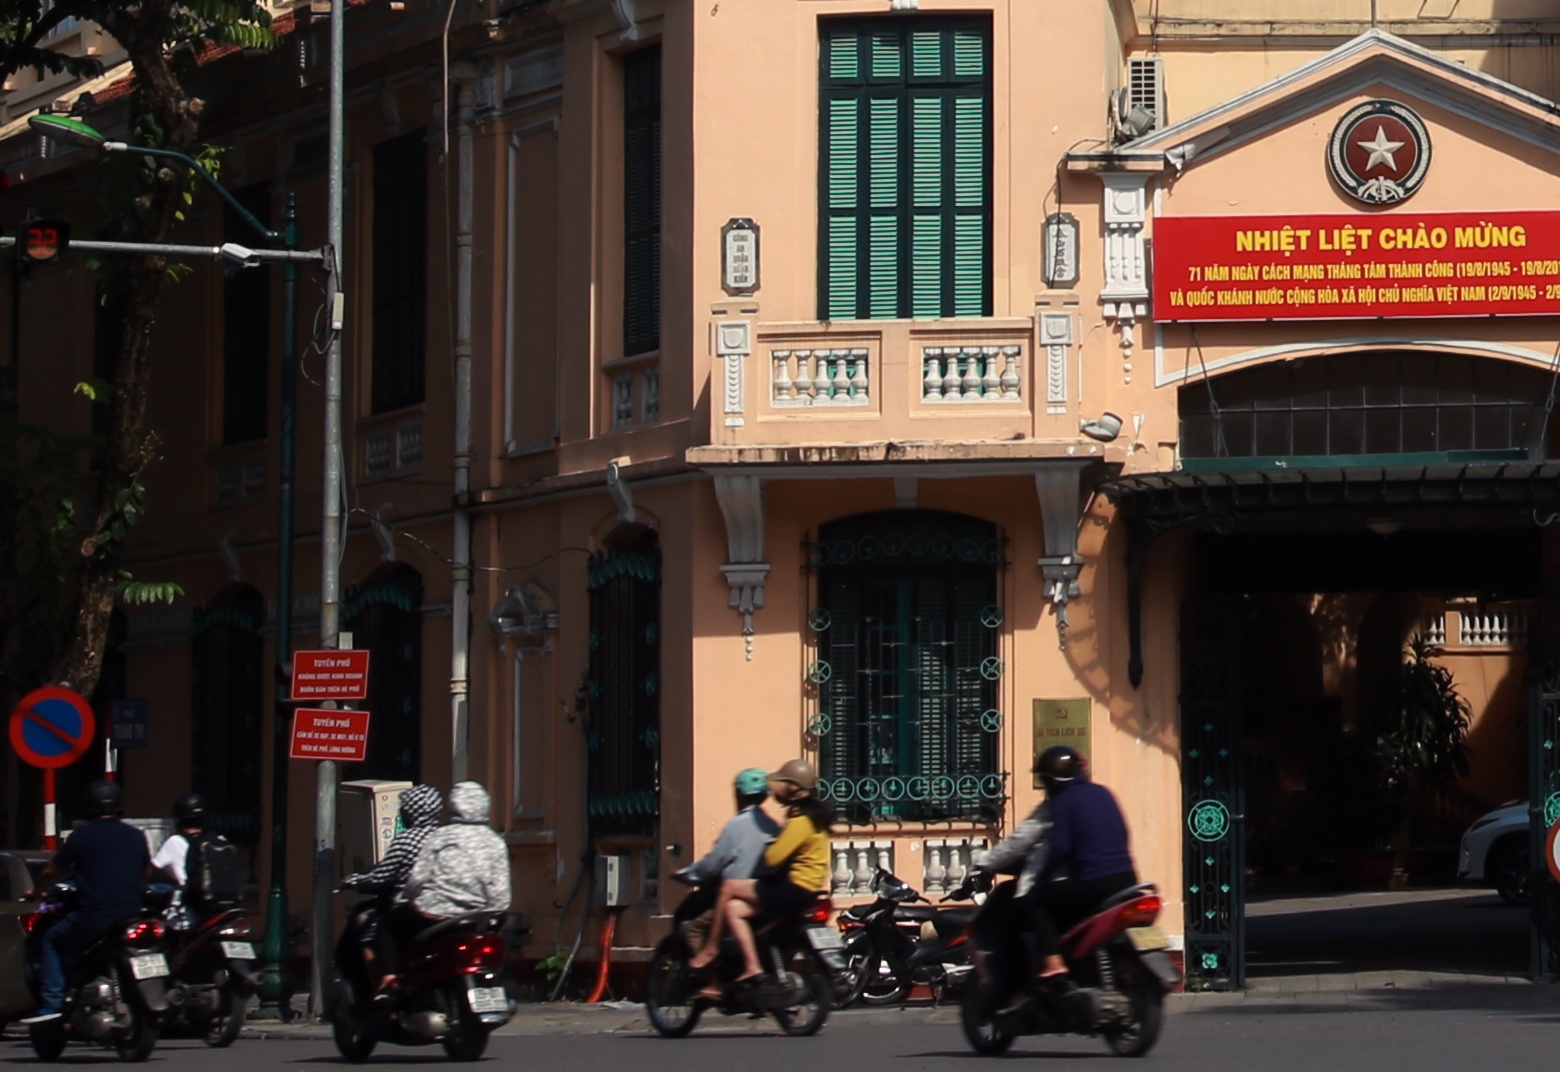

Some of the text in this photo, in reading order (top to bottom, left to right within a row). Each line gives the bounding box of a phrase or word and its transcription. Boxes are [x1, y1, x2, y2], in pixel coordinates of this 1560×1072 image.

[1236, 220, 1527, 256] NHIỆT LIỆT CHÀO MỪNG
[1188, 266, 1201, 281] 71
[1205, 263, 1229, 281] NĂM
[1232, 263, 1260, 281] NGÀY
[1263, 262, 1291, 280] CÁCH
[1293, 265, 1324, 282] MẠNG
[1327, 261, 1361, 279] THÁNG
[1363, 261, 1386, 278] TÁM
[1388, 260, 1422, 278] THÀNH
[1425, 259, 1454, 278] CÔNG
[1457, 261, 1511, 278] (19/8/1945
[1170, 288, 1184, 306] VÀ
[1187, 286, 1214, 308] QUỐC
[1217, 288, 1253, 306] KHÁNH
[1256, 286, 1284, 305] NƯỚC
[1287, 286, 1316, 307] CỘNG
[1318, 285, 1339, 304] HÒA
[1341, 285, 1356, 304] XÃ
[1358, 285, 1376, 306] HỘI
[1379, 283, 1400, 303] CHỦ
[1402, 284, 1434, 302] NGHĨA
[1437, 284, 1458, 305] VIỆT
[1461, 286, 1485, 301] NAM
[1488, 285, 1537, 302] (2/9/1945
